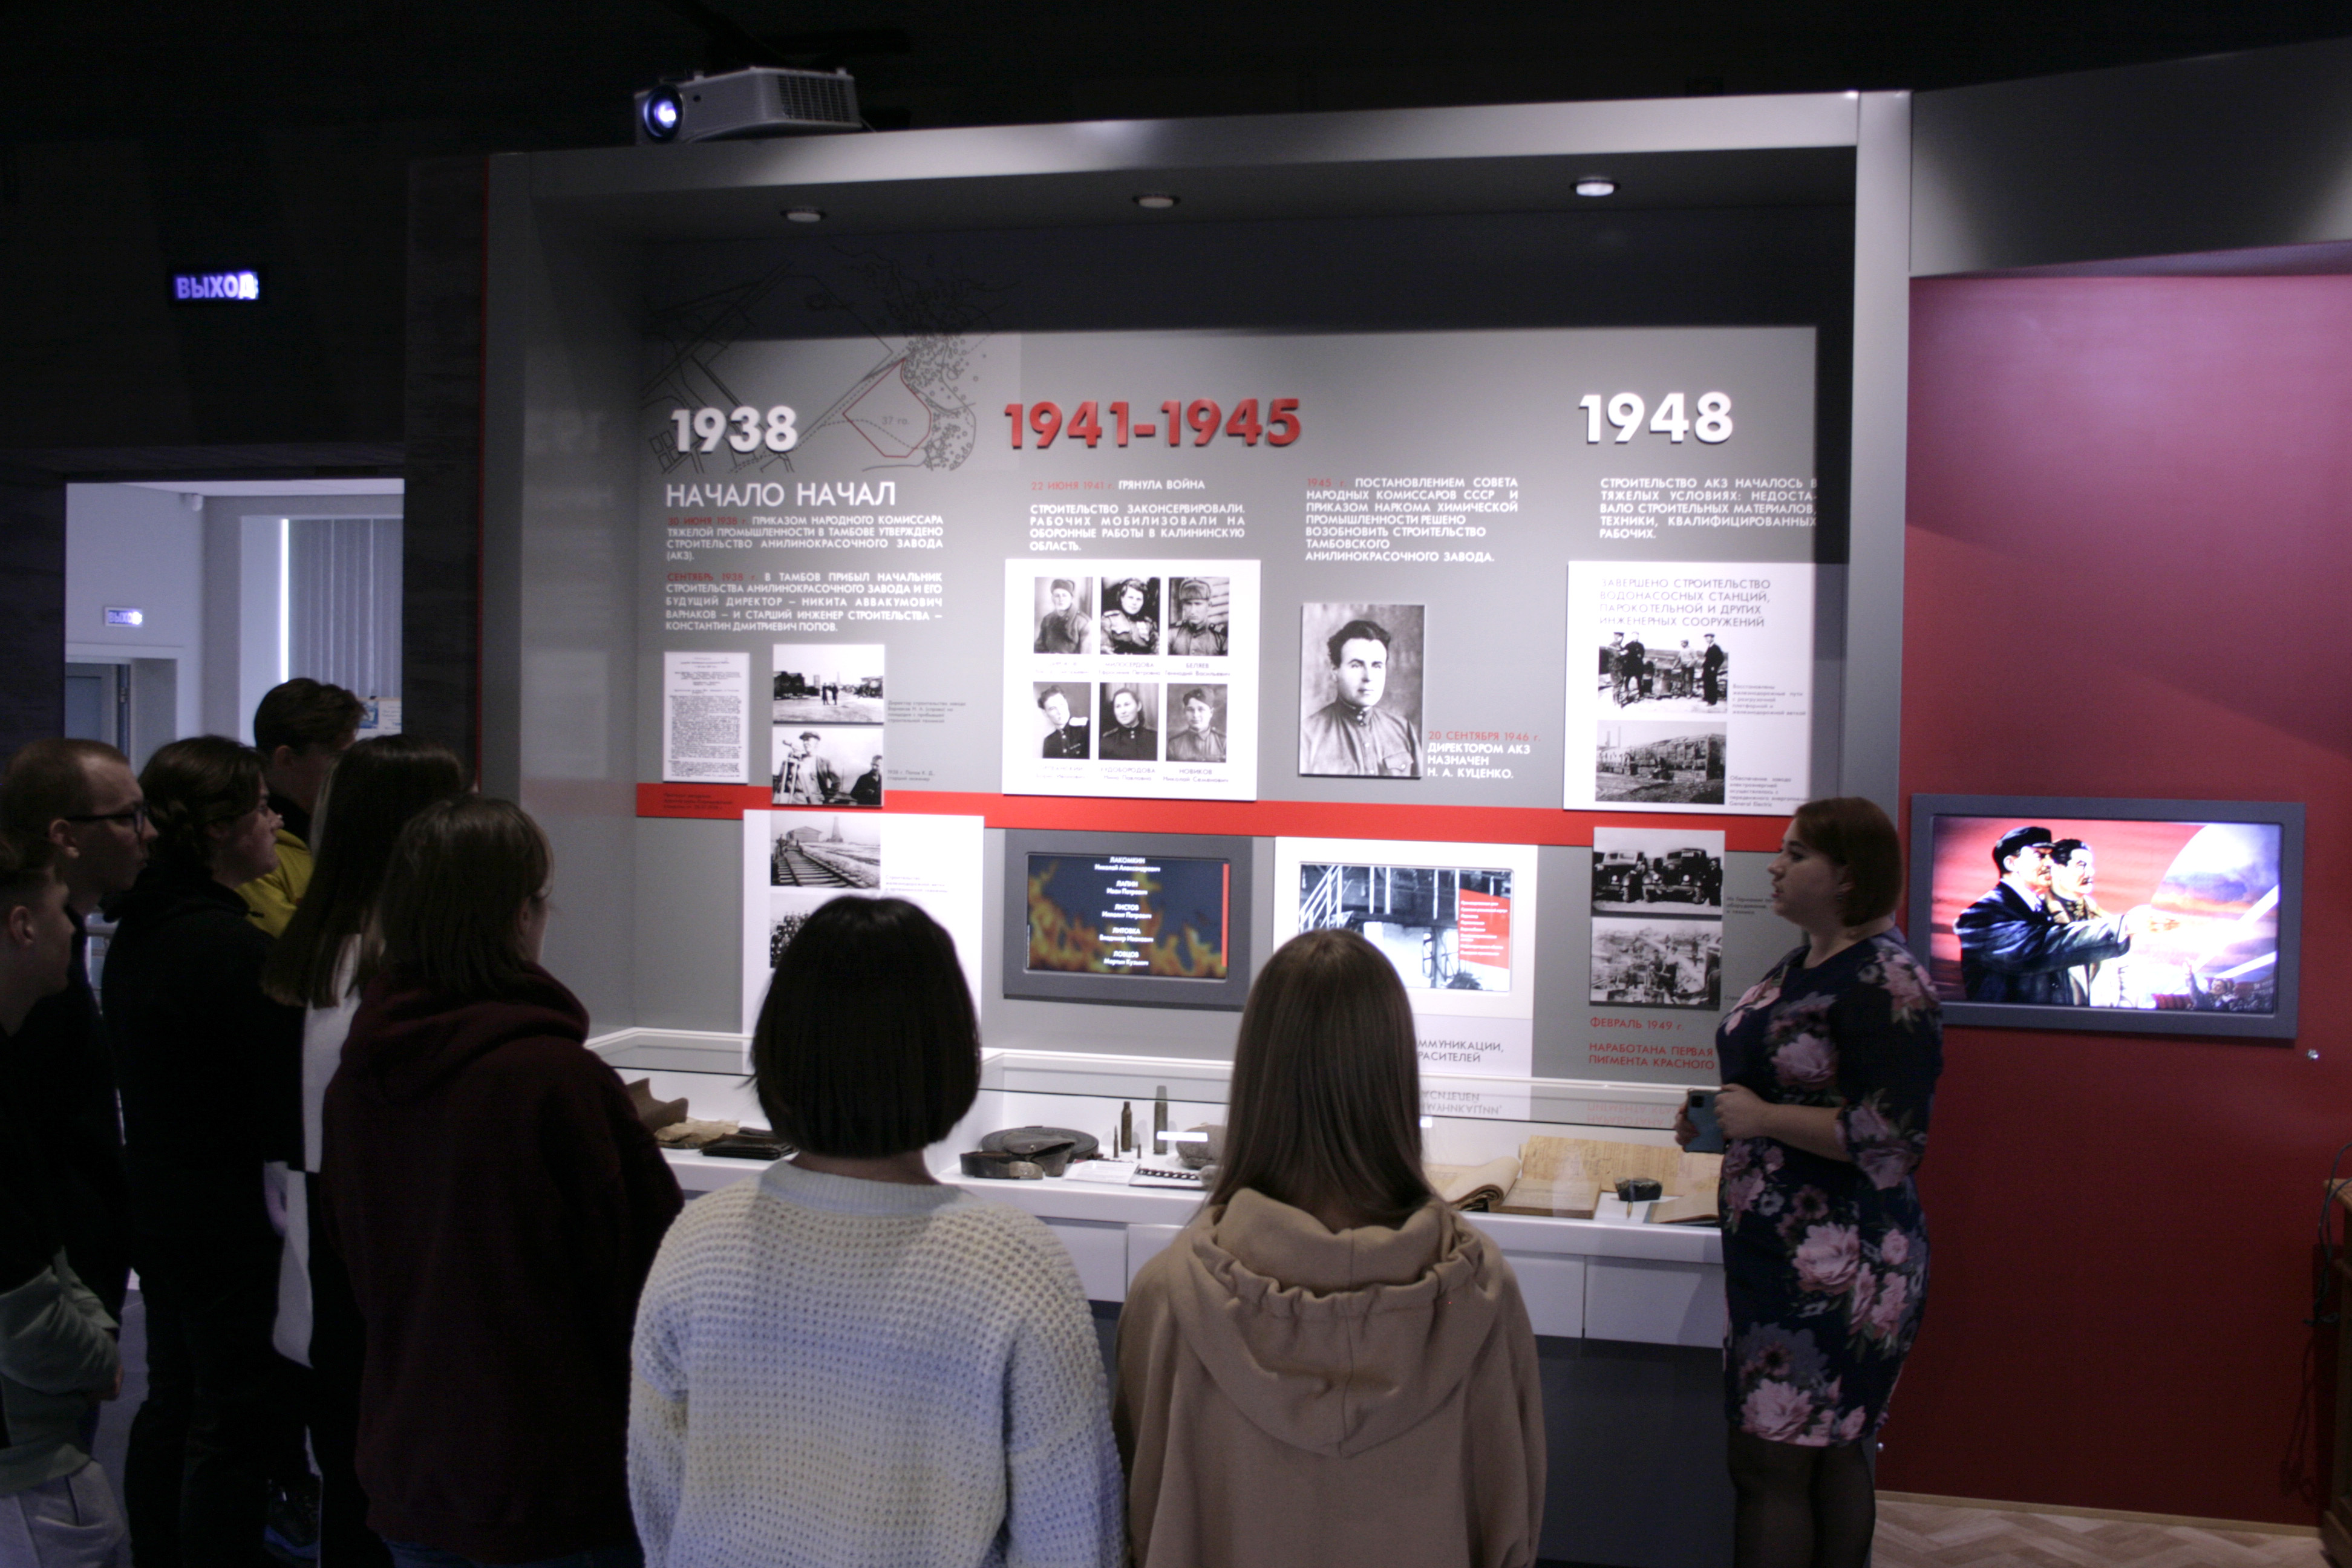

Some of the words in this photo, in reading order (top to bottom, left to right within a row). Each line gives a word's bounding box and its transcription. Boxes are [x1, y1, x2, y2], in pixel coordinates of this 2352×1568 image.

[177, 274, 256, 299] ВЫХОД
[1579, 392, 1733, 443] 1948
[671, 406, 798, 452] 1938
[1032, 482, 1044, 490] 22
[1119, 480, 1162, 489] ГРЯНУЛА
[1308, 478, 1332, 487] 1945
[1356, 478, 1465, 487] ПОСТАНОВЛЕНИЕМ
[1473, 477, 1518, 487] СОВЕТА
[1601, 479, 1697, 488] СТРОИТЕЛЬСТВО
[1705, 479, 1728, 488] АКЗ
[1736, 479, 1803, 488] НАЧАЛОСЬ
[667, 483, 784, 506] НАЧАЛО
[797, 482, 895, 506] НАЧАЛ
[1307, 491, 1368, 500] НАРОДНЫХ
[1376, 490, 1456, 500] КОМИССАРОВ
[1464, 490, 1494, 500] СССР
[1509, 490, 1518, 500] И
[1601, 491, 1659, 500] ТЯЖЕЛЫХ
[1030, 505, 1119, 514] СТРОИТЕЛЬСТВО
[1128, 504, 1244, 514] ЗАКОНСЕРВИРОВАЛИ.
[1307, 503, 1368, 512] ПРИКАЗОМ
[1375, 503, 1431, 512] НАРКОМА
[1437, 501, 1518, 512] ХИМИЧЕСКОЙ
[1600, 503, 1633, 513] ВАЛО
[1638, 503, 1728, 513] СТРОИТЕЛЬНЫХ
[684, 517, 712, 525] ИЮНЯ
[716, 517, 738, 525] 1938
[811, 516, 874, 525] НАРОДНОГО
[878, 515, 943, 524] КОМИССАРА
[1030, 517, 1090, 526] РАБОЧИХ
[1101, 516, 1217, 526] МОБИЛИЗОВАЛИ
[1227, 517, 1245, 525] НА
[1306, 515, 1418, 524] ПРОМЫШЛЕННОСТИ
[1421, 515, 1466, 524] РЕШЕНО
[1600, 515, 1658, 528] ТЕХНИКИ,
[1668, 515, 1817, 528] КВАЛИФИЦИРОВАННЫХ
[668, 528, 713, 537] ТЯЖЕЛОЙ
[717, 528, 815, 537] ПРОМЫШЛЕННОСТИ
[818, 528, 824, 536] В
[829, 528, 874, 536] ТАМБОВЕ
[879, 527, 943, 537] УТВЕРЖДЕНО
[1030, 529, 1096, 538] ОБОРОННЫЕ
[1102, 528, 1143, 538] РАБОТЫ
[1149, 528, 1155, 537] В
[1161, 528, 1244, 537] КАЛИНИНСКУЮ
[1306, 527, 1388, 536] ВОЗОБНОВИТЬ
[1393, 527, 1486, 537] СТРОИТЕЛЬСТВО
[1600, 529, 1655, 538] РАБОЧИХ.
[667, 540, 753, 548] СТРОИТЕЛЬСТВО
[761, 539, 888, 547] АНИЛИНОКРАСОЧНОГО
[897, 538, 943, 549] ЗАВОДА
[1030, 541, 1081, 550] ОБЛАСТЬ.
[1307, 539, 1390, 549] ТАМБОВСКОГО
[1305, 552, 1439, 561] АНИЛИНОКРАСОЧНОГО
[1444, 552, 1494, 563] ЗАВОДА.
[667, 572, 714, 581] СЕНТЯБРЬ
[780, 573, 820, 581] ТАМБОВ
[829, 573, 869, 581] ПРИБЫЛ
[878, 573, 942, 581] НАЧАЛЬНИК
[747, 584, 864, 593] АНИЛИНОКРАСОЧНОГО
[868, 584, 910, 594] ЗАВОДА
[913, 584, 921, 593] И
[924, 584, 942, 593] ЕГО
[1602, 579, 1668, 587] ЗАВЕРШЕНО
[1674, 579, 1771, 589] СТРОИТЕЛЬСТВО
[666, 596, 718, 606] БУДУЩИЙ
[726, 597, 782, 606] ДИРЕКТОР
[802, 598, 847, 606] НИКИТА
[855, 598, 942, 607] АВВАКУМОВИЧ
[1600, 592, 1704, 601] ВОДОНАСОСНЫХ
[1600, 604, 1702, 613] ПАРОКОТЕЛЬНОЙ
[1708, 604, 1716, 613] И
[1720, 605, 1761, 615] ДРУГИХ
[666, 610, 716, 619] ВАРНАКОВ
[745, 610, 792, 619] СТАРШИЙ
[797, 611, 843, 619] ИНЖЕНЕР
[848, 611, 930, 620] СТРОИТЕЛЬСТВА
[1600, 617, 1676, 626] ИНЖЕНЕРНЫХ
[1682, 616, 1765, 627] СООРУЖЕНИЙ
[733, 622, 797, 631] ДМИТРИЕВИЧ
[799, 622, 838, 632] ПОПОВ.
[1429, 731, 1442, 740] 20
[1446, 731, 1500, 740] СЕНТЯБРЯ
[1505, 732, 1529, 741] 1946
[1428, 743, 1503, 753] ДИРЕКТОРОМ
[1508, 745, 1530, 754] АКЗ
[1428, 756, 1489, 765] НАЗНАЧЕН
[1428, 767, 1438, 776] Н.
[1442, 768, 1453, 777] А.
[1457, 768, 1513, 779] КУЦЕНКО.
[1590, 1017, 1642, 1028] ФЕВРАЛЬ
[1648, 1020, 1673, 1030] 1949
[1417, 1039, 1504, 1053] ММУНИКАЦИИ,
[1589, 1042, 1666, 1054] НАРАБОТАНА
[1671, 1046, 1713, 1057] ПЕРВАЯ
[1418, 1051, 1480, 1062] РАСИТЕЛЕЙ
[1589, 1054, 1648, 1067] ПИГМЕНТА
[1653, 1058, 1714, 1070] КРАСНОГО
